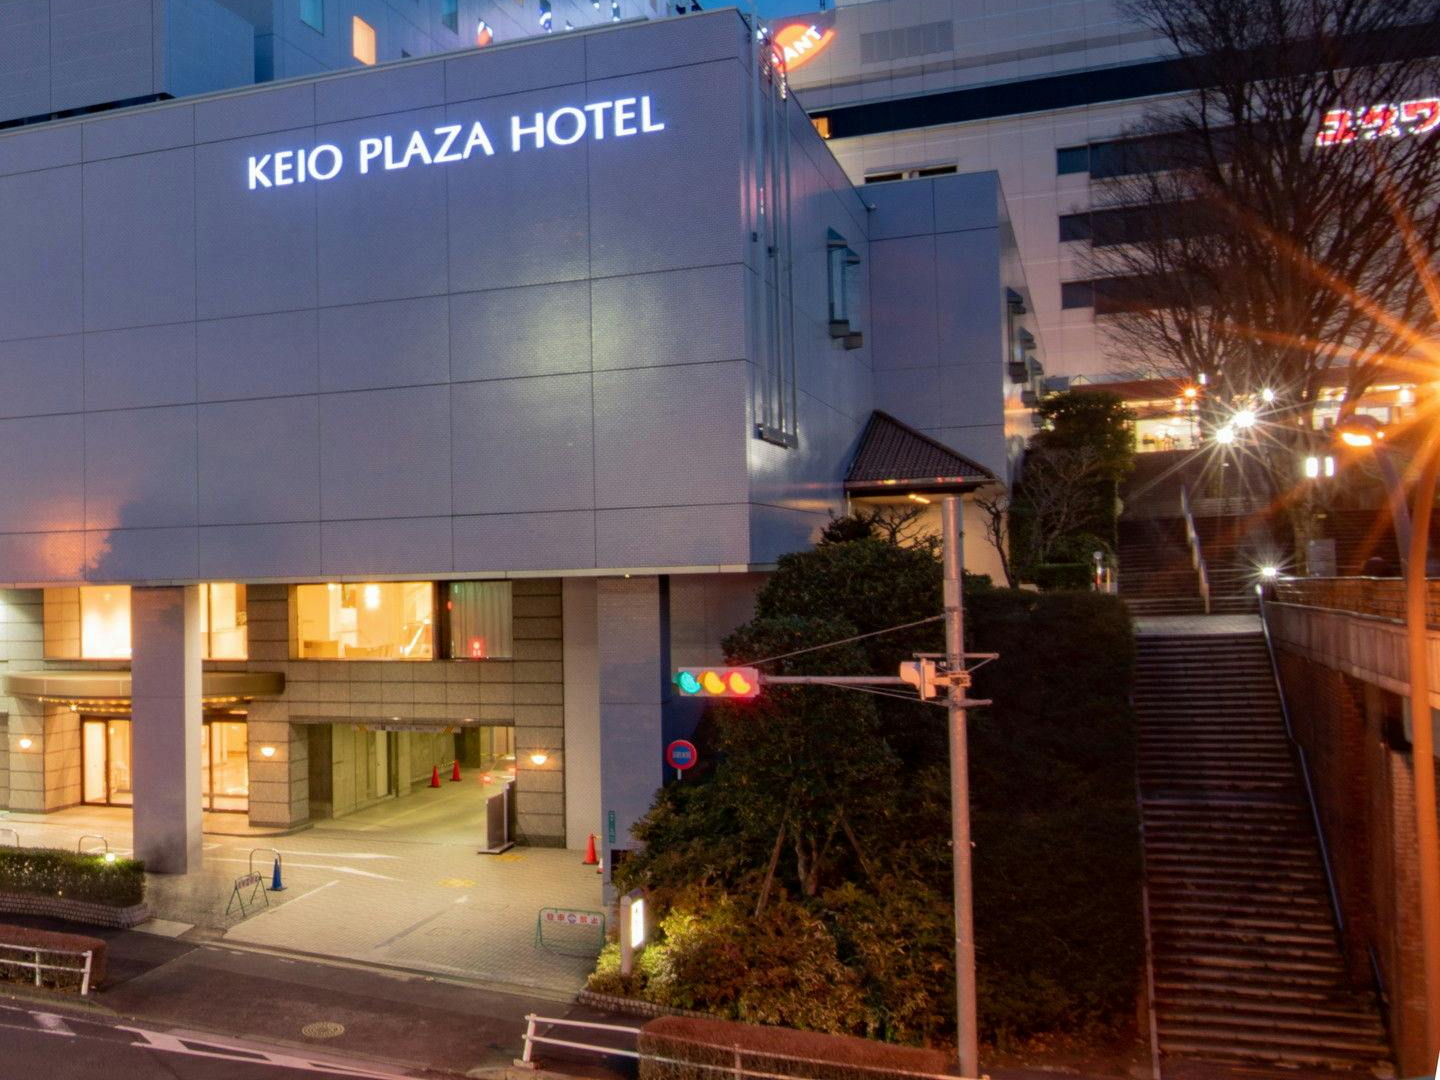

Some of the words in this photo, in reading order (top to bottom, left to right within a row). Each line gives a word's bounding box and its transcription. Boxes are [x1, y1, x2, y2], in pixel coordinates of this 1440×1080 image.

[771, 24, 822, 64] ANT
[248, 143, 344, 190] KEIO
[359, 121, 495, 174] PLAZA
[511, 95, 665, 151] HOTEL
